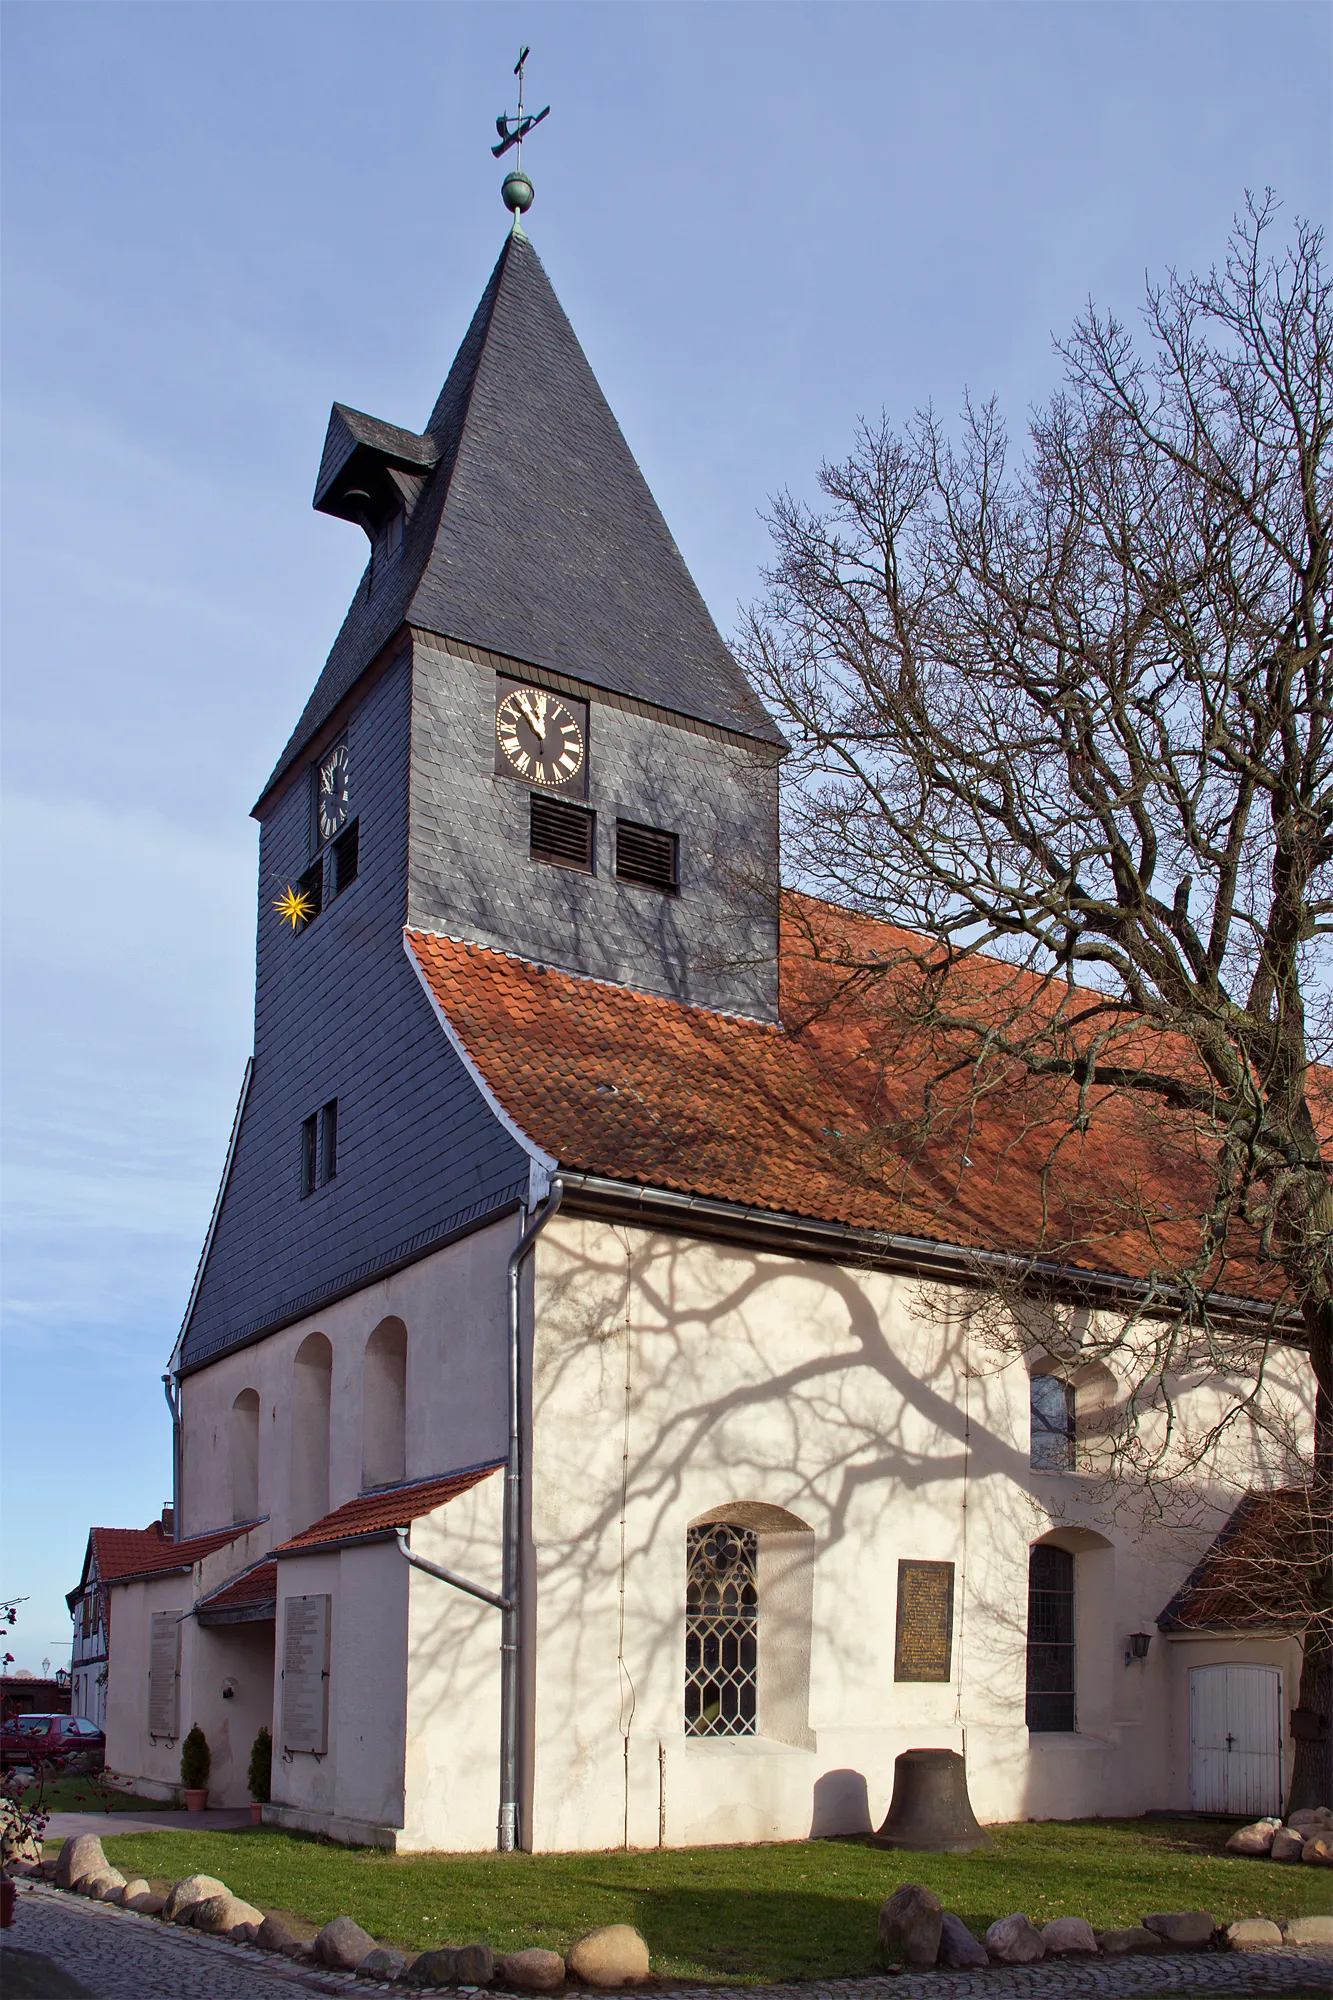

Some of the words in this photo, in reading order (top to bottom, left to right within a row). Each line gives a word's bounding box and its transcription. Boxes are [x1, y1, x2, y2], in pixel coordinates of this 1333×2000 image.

[504, 703, 521, 721] X
[551, 706, 562, 720] I
[552, 762, 563, 780] V
